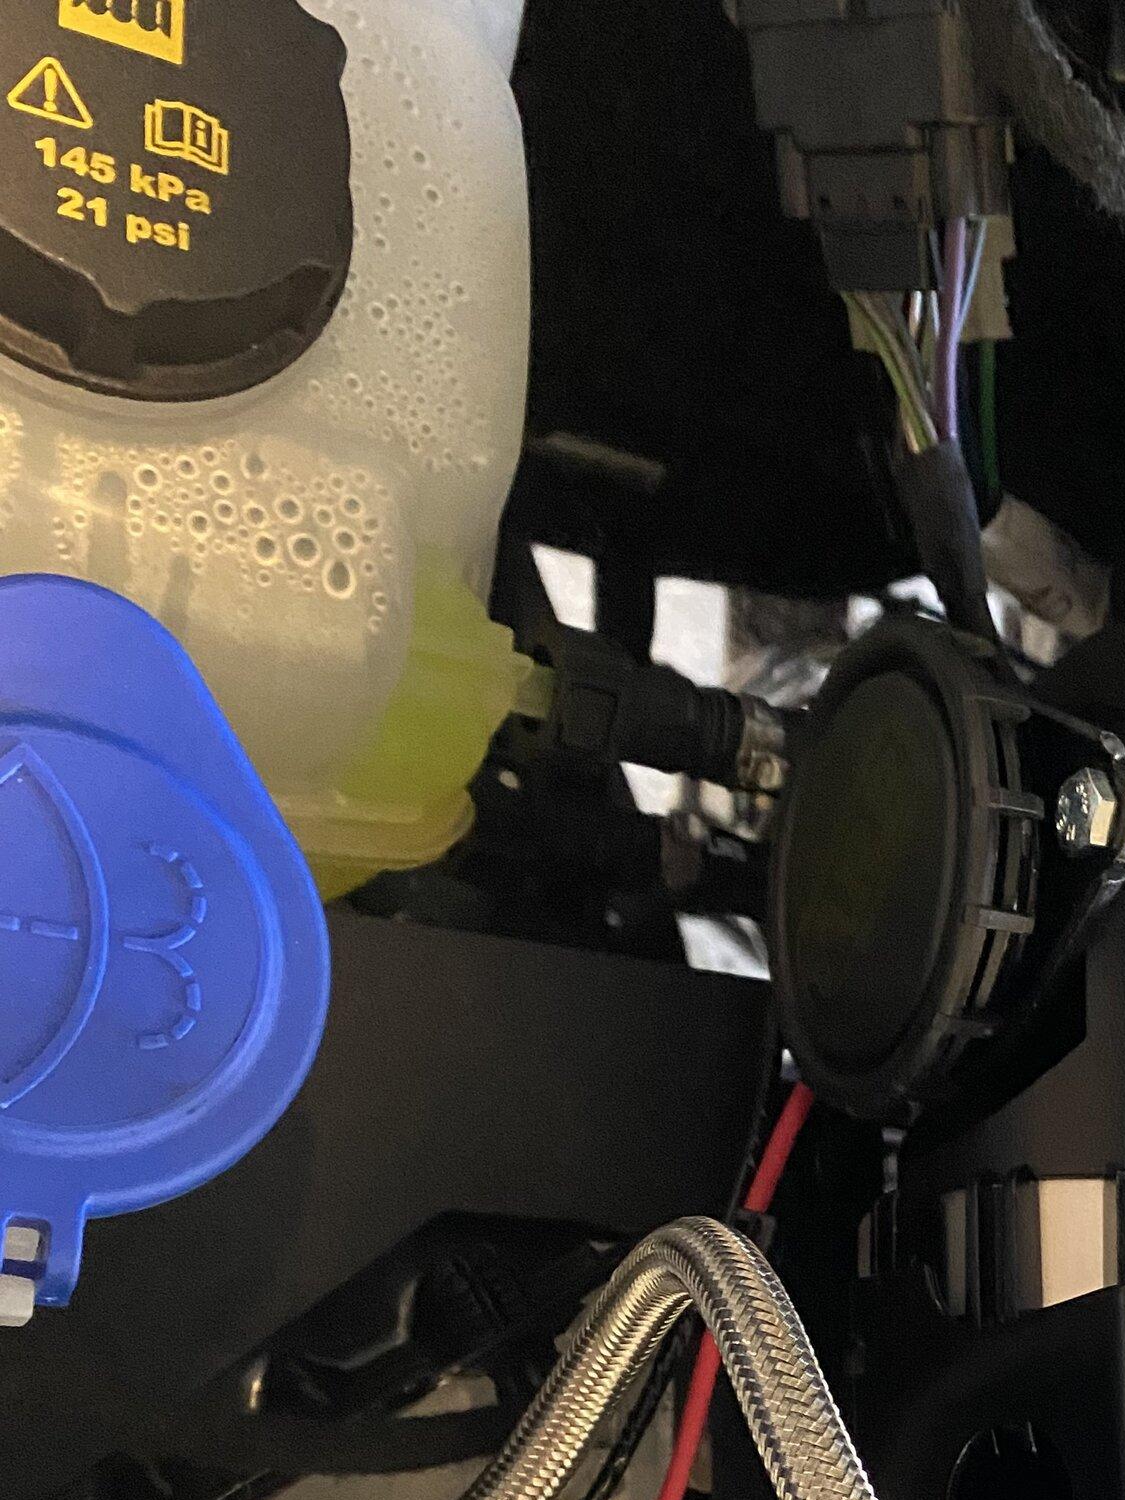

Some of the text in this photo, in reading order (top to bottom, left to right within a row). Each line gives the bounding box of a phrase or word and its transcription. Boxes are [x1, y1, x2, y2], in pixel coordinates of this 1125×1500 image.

[35, 137, 212, 214] 145 kPa
[57, 187, 190, 251] 21 psi
